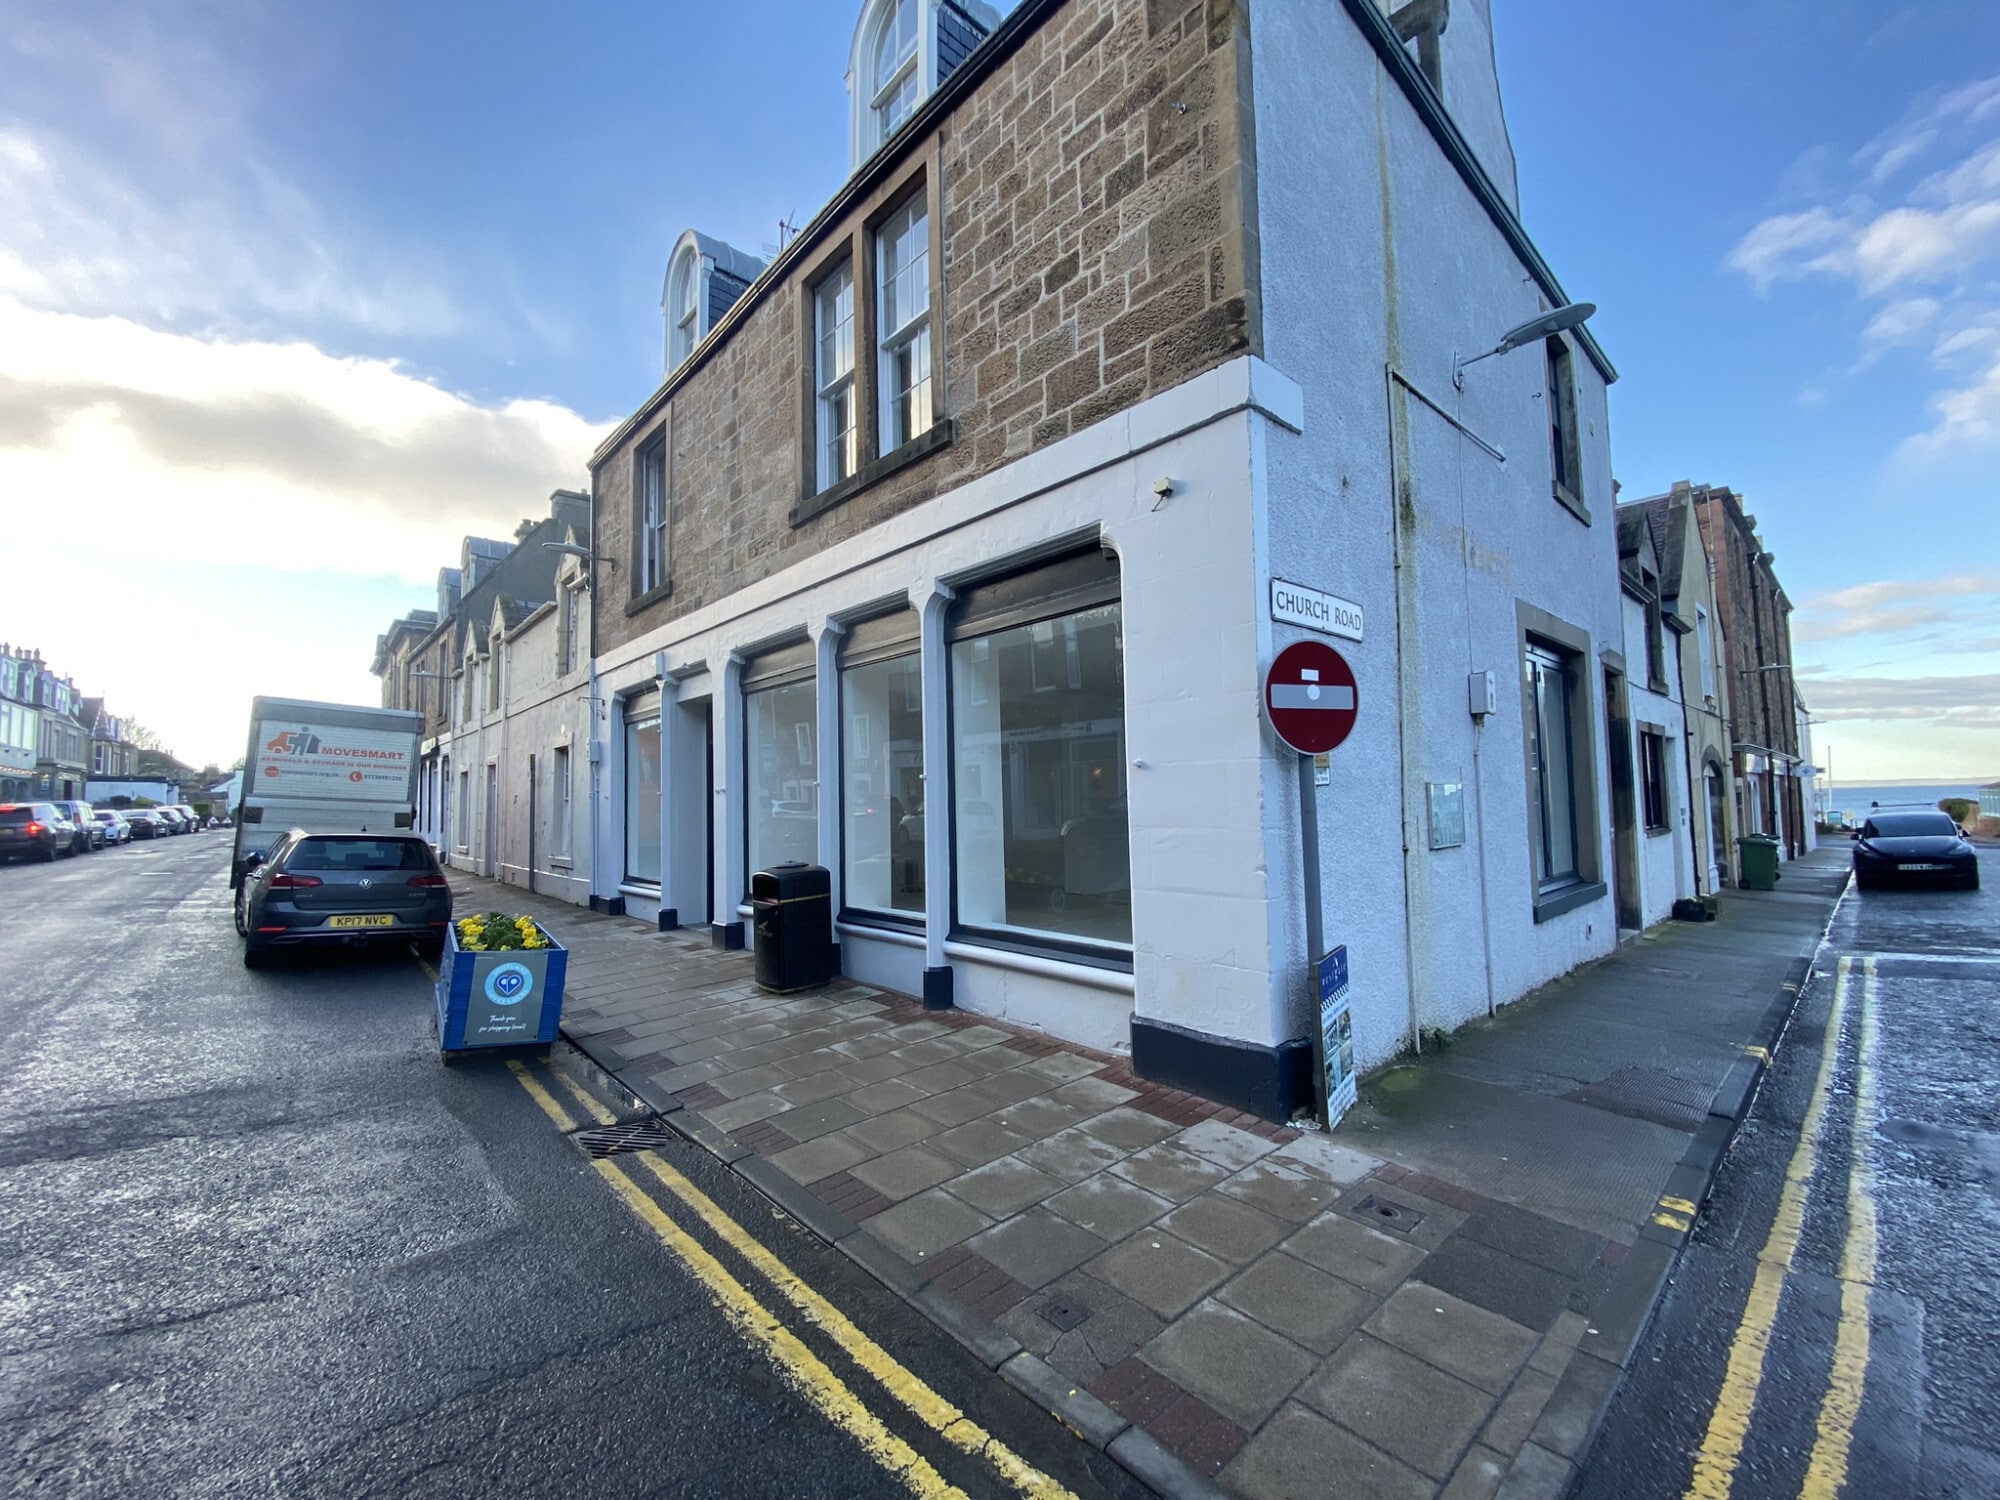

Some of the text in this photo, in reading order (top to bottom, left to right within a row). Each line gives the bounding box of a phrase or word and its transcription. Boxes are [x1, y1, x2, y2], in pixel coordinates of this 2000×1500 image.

[1276, 591, 1362, 631] CHURCH ROAD
[322, 747, 405, 760] MOVESMART
[336, 916, 387, 926] KP17 NVC
[489, 1014, 505, 1023] Thank
